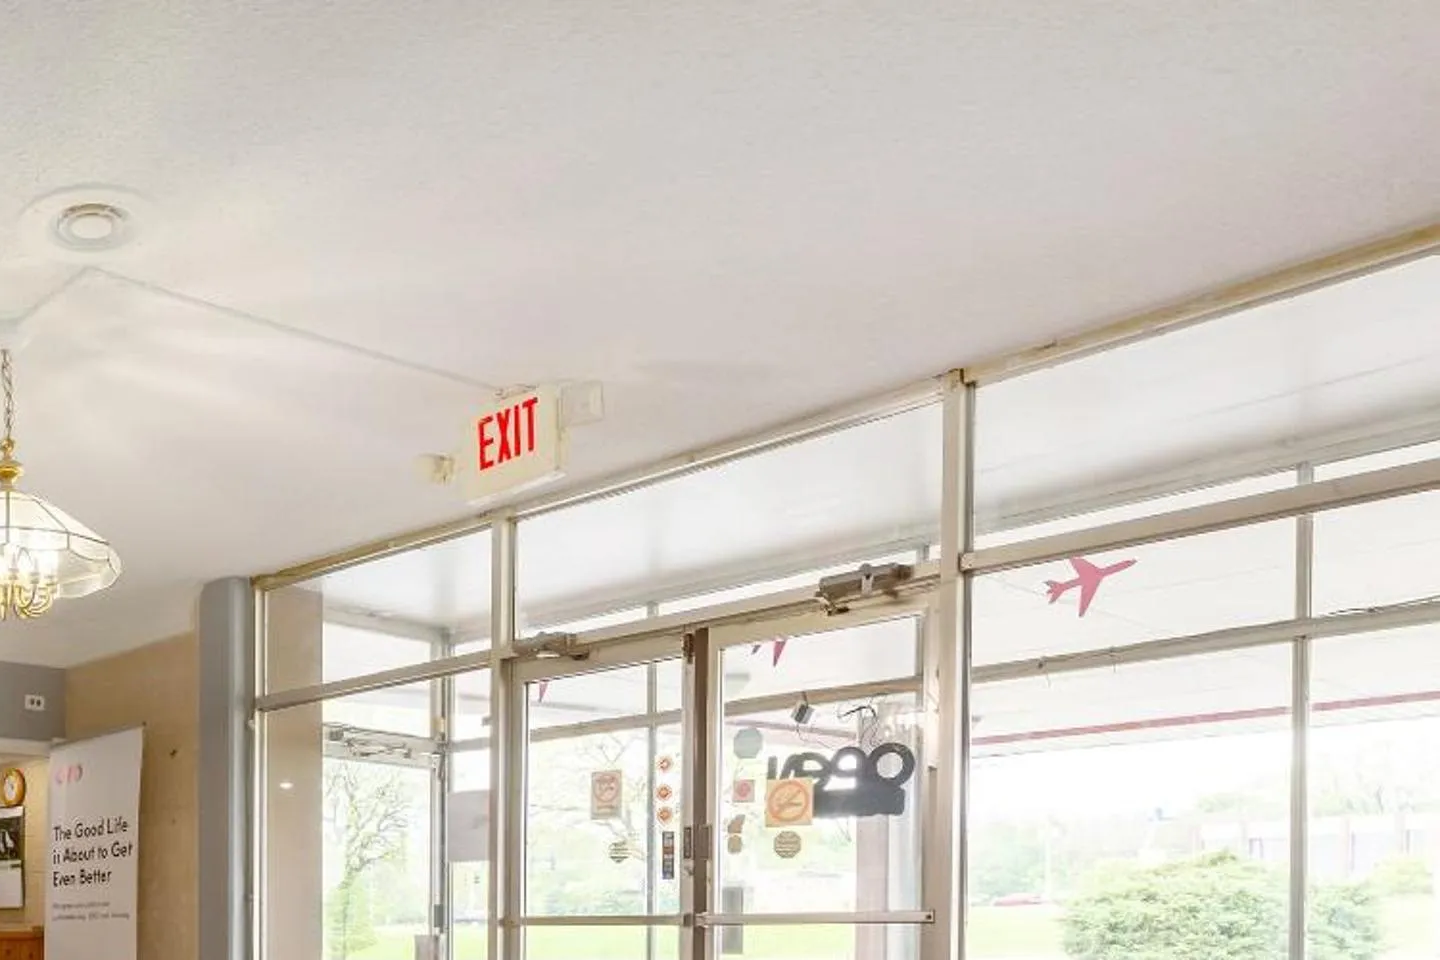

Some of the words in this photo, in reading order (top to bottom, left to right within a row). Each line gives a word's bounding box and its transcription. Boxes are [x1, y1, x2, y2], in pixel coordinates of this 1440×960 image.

[478, 397, 538, 471] EXIT
[53, 825, 72, 842] The
[74, 817, 105, 839] Good
[106, 816, 129, 835] Life
[63, 846, 95, 863] About
[98, 846, 109, 860] to
[111, 840, 134, 858] Get
[52, 870, 76, 888] Even
[79, 868, 113, 885] Better
